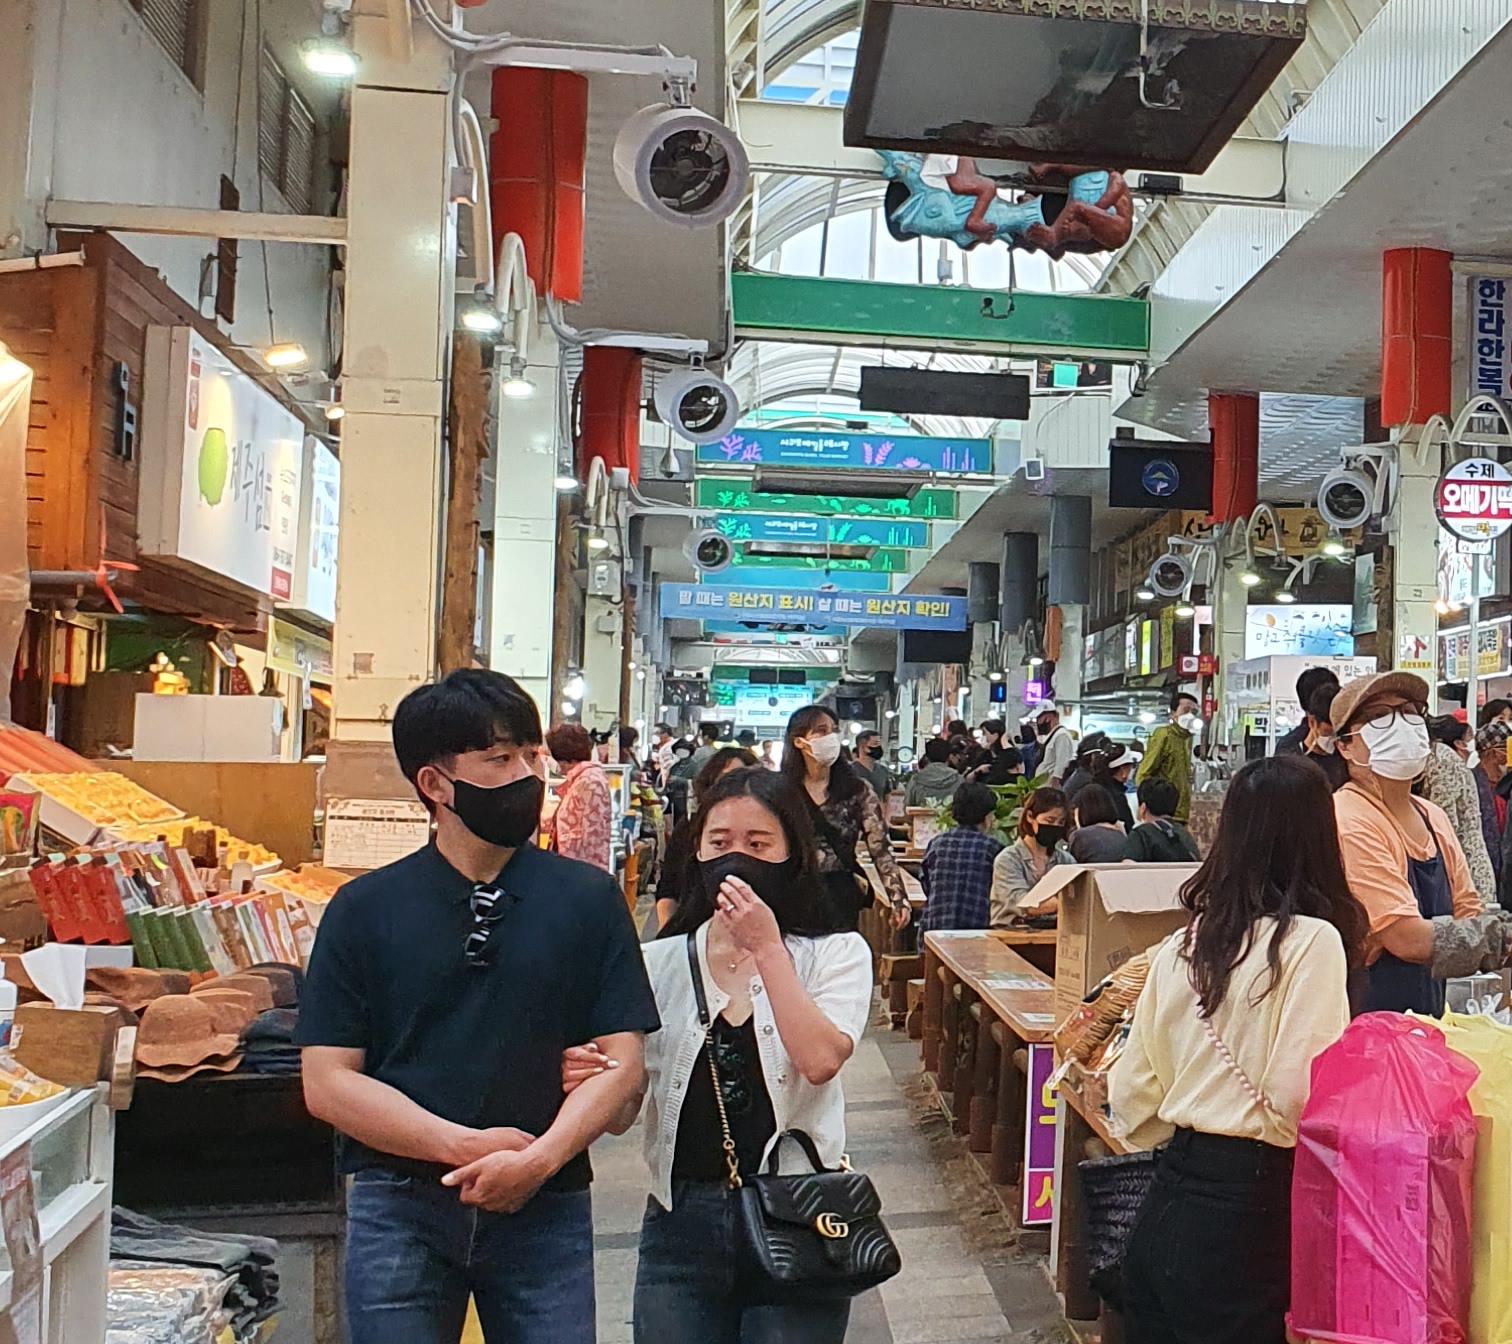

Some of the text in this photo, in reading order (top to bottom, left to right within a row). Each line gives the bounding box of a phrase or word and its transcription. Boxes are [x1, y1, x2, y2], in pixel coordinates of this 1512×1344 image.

[1477, 279, 1506, 396] 한라한복
[1465, 462, 1495, 479] 수제
[696, 590, 725, 607] 때는
[728, 591, 774, 609] 원산지
[777, 594, 814, 611] 표시!
[817, 597, 832, 612] 살
[835, 598, 863, 613] 때는
[866, 598, 911, 616] 원산지
[915, 600, 950, 617] 확인!
